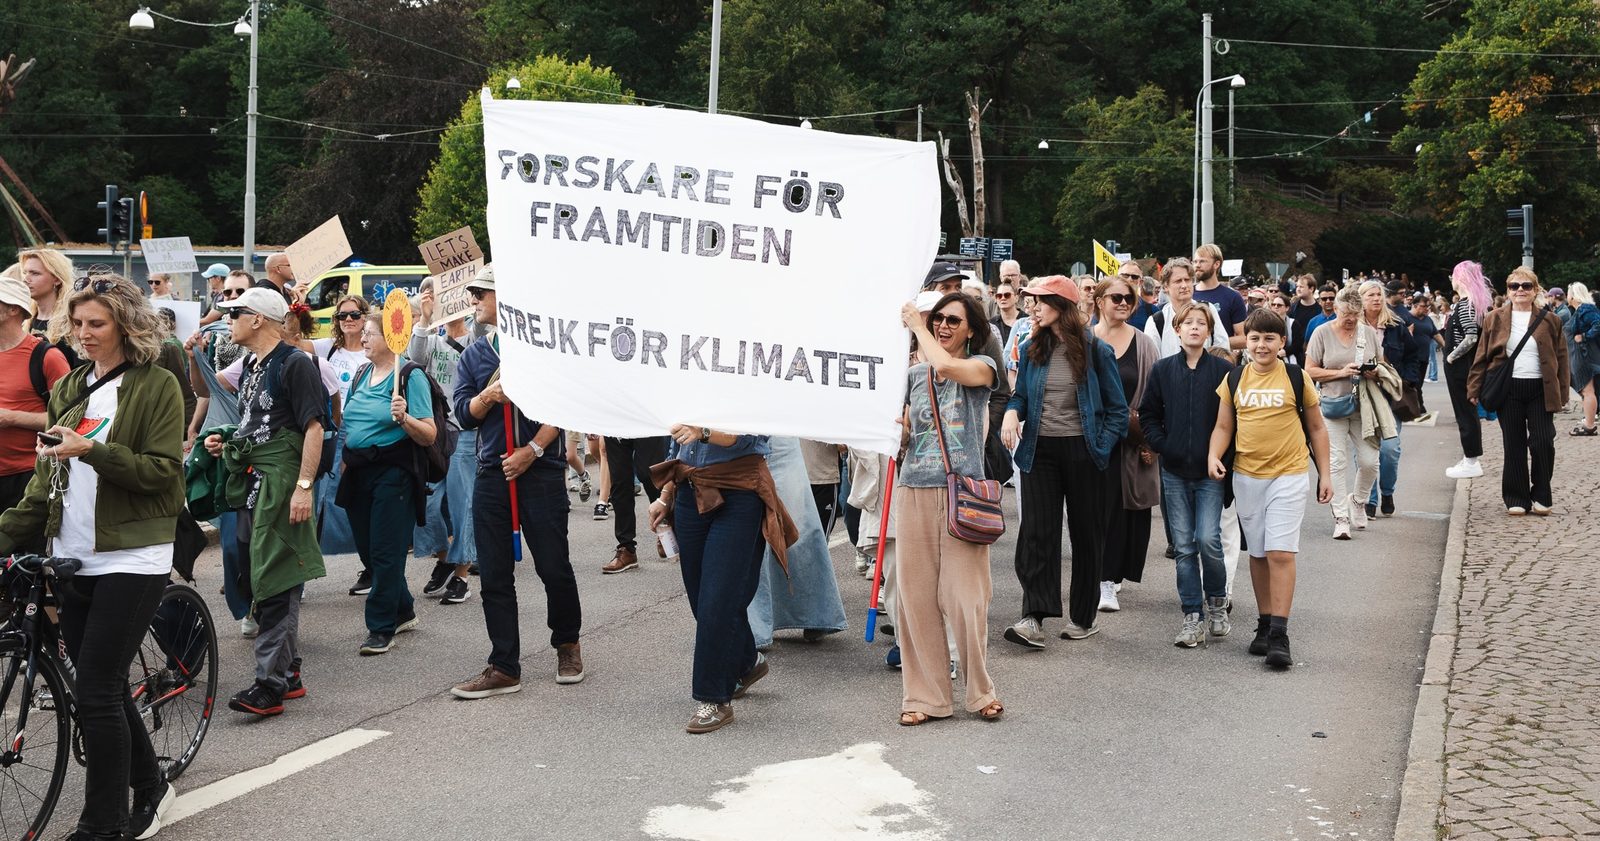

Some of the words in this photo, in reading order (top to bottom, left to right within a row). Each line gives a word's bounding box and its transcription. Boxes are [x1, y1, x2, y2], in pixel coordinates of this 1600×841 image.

[498, 149, 733, 206] FORSKARE
[753, 169, 846, 220] FÖR
[529, 200, 794, 267] FRAMTIDEN
[426, 235, 469, 262] LET'S
[440, 249, 474, 272] MAKE
[440, 264, 476, 288] EARTH
[440, 284, 468, 304] GREA
[498, 301, 580, 357] STREJK
[587, 317, 669, 368] FÖR
[679, 334, 884, 391] KLIMATET
[1236, 387, 1285, 408] VANS
